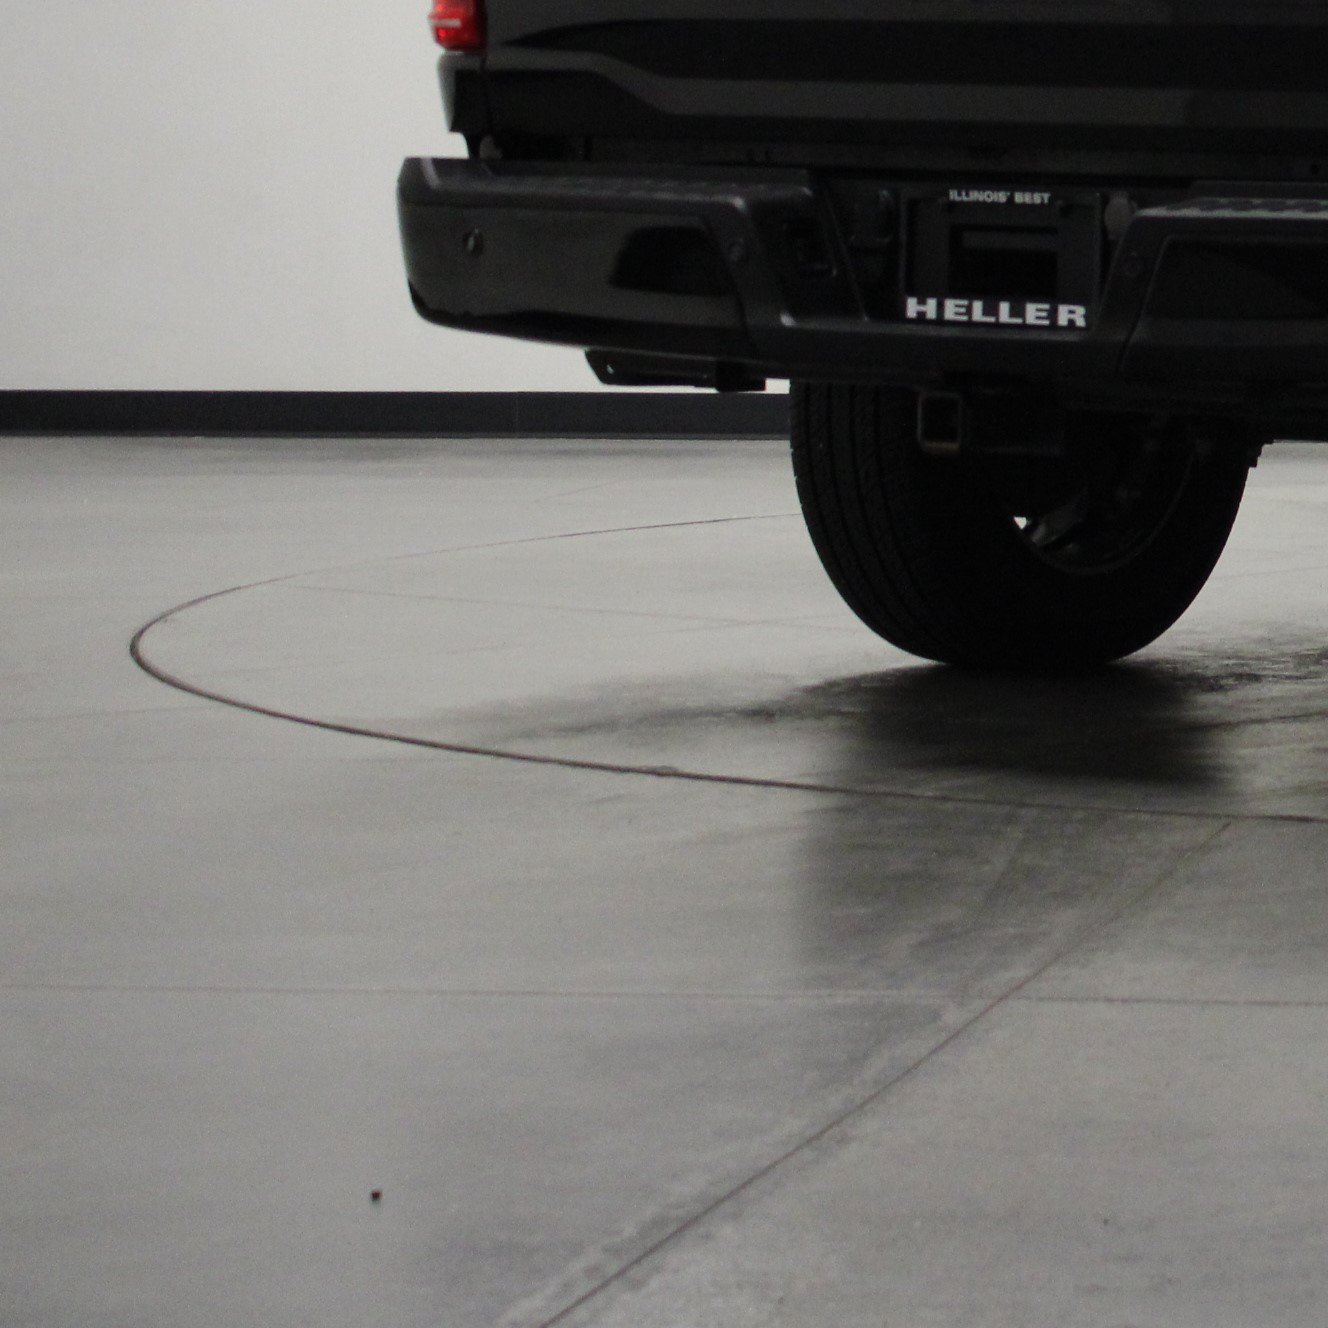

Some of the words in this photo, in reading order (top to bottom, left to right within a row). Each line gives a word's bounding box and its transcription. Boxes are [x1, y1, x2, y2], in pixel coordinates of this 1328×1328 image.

[949, 189, 1011, 203] ILLINOIS'
[1014, 192, 1050, 204] BEST
[905, 296, 1087, 328] HELLER
